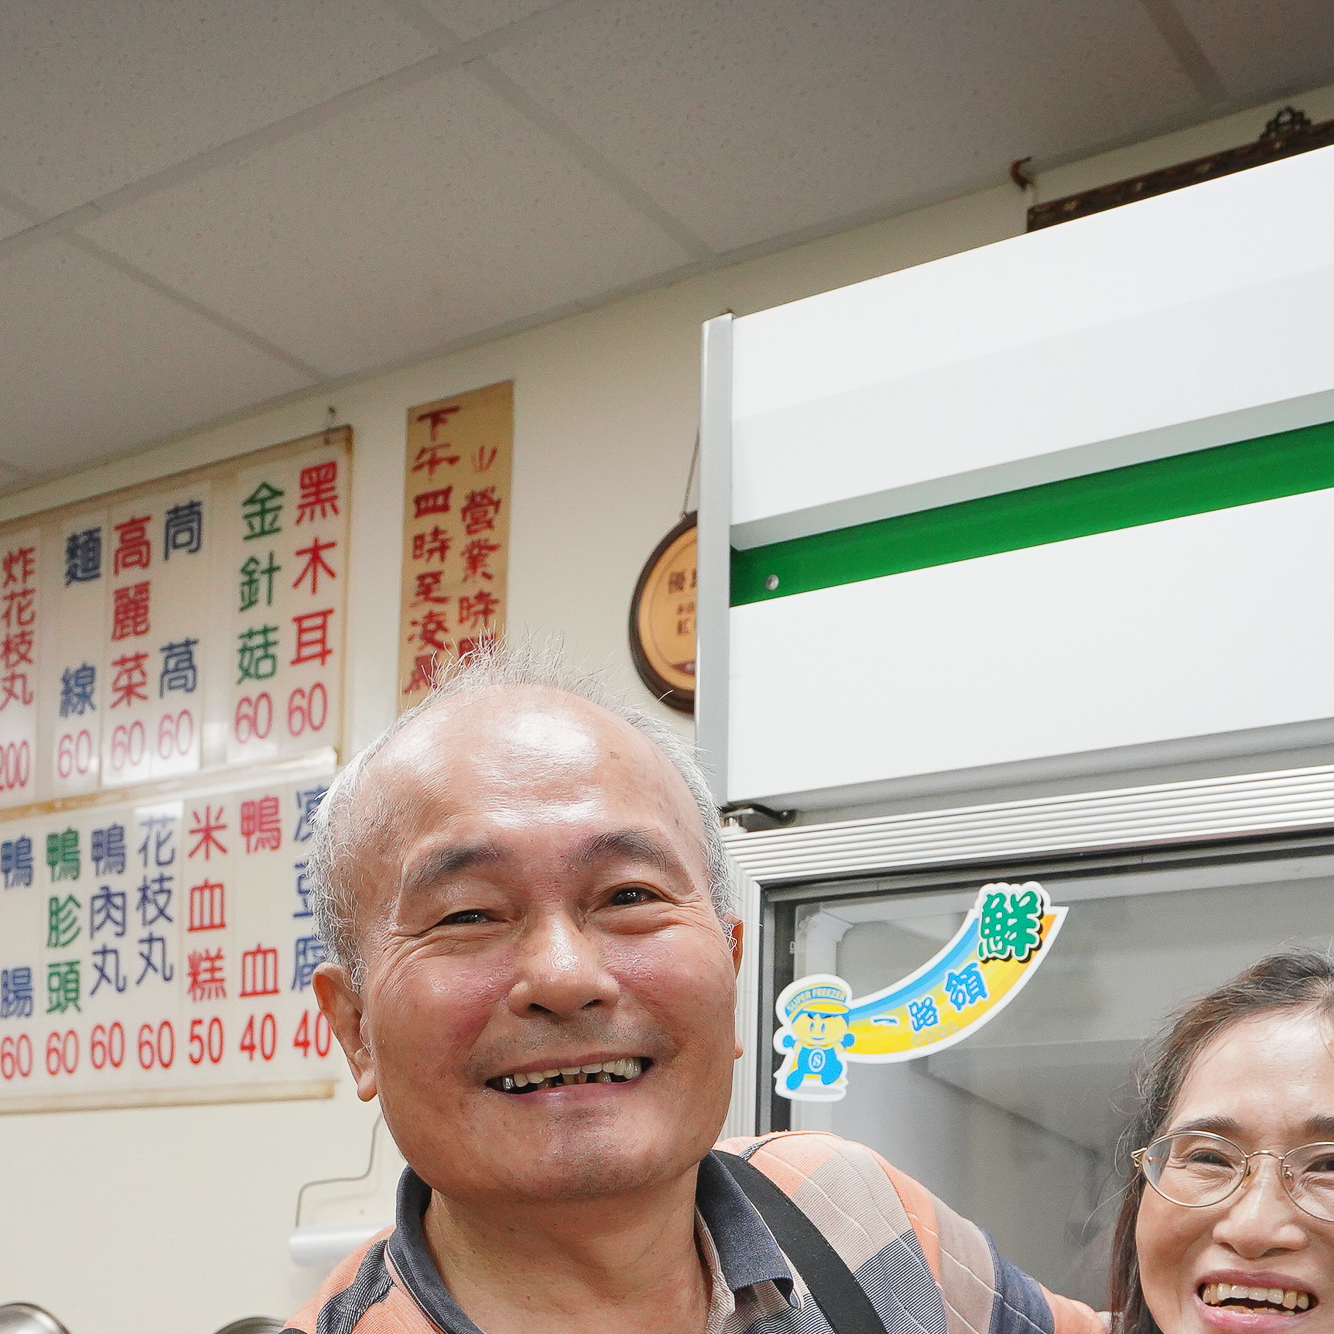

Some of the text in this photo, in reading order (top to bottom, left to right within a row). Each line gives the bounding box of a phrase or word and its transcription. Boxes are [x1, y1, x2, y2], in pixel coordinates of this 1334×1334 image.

[0, 546, 36, 711] 炸花枝丸
[111, 514, 152, 771] 高麗菜 60
[235, 481, 284, 744] 金針菇 60
[287, 461, 338, 736] 黑木耳 60
[58, 729, 92, 778] 60
[158, 709, 193, 761] 60
[90, 822, 127, 1070] 鴨肉丸 60
[136, 816, 177, 1070] 花枝丸 60
[187, 804, 227, 1065] 米血糕 50
[0, 1034, 33, 1080] 60
[46, 1029, 80, 1076] 60
[240, 1013, 277, 1061] 40
[293, 1009, 332, 1058] 40
[912, 1021, 960, 1046] COOL
